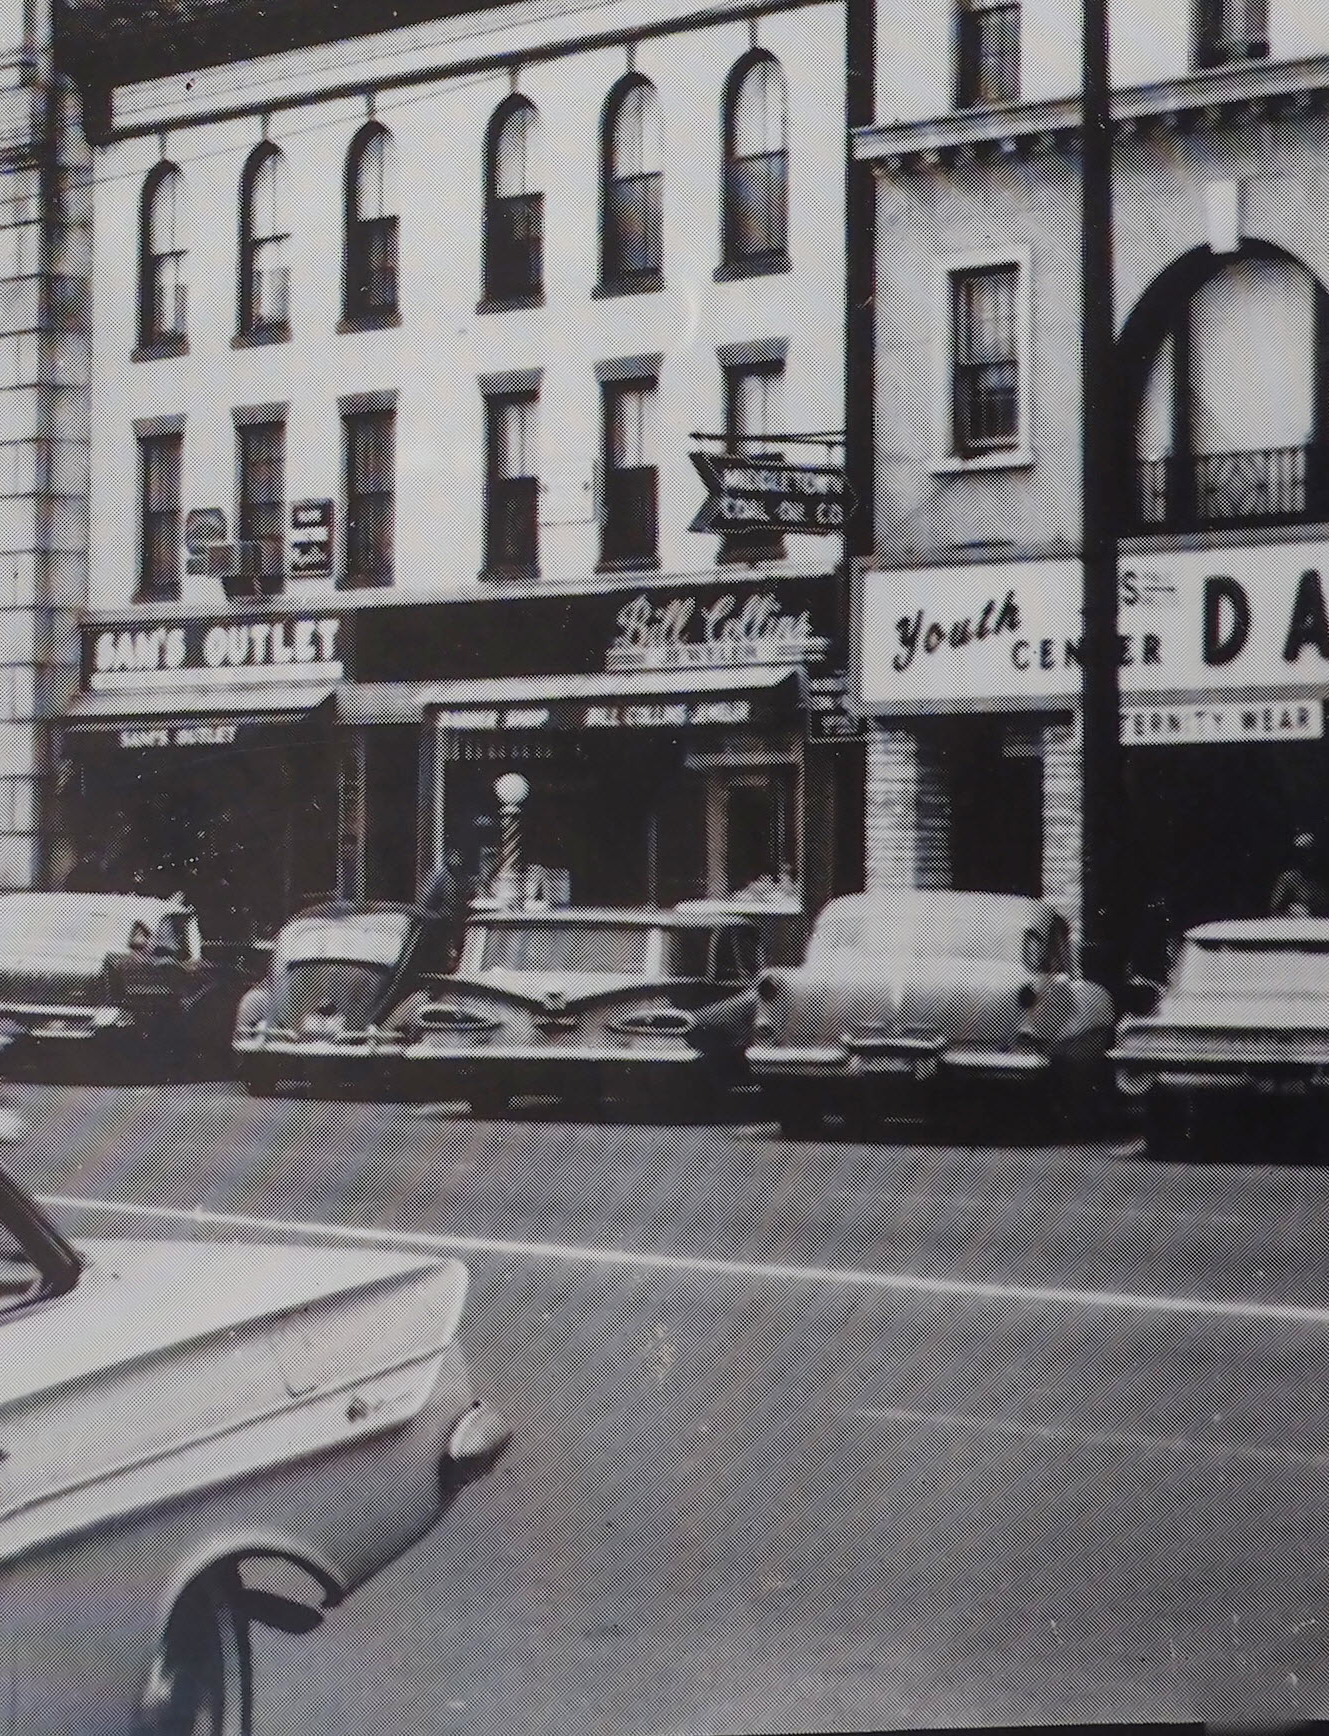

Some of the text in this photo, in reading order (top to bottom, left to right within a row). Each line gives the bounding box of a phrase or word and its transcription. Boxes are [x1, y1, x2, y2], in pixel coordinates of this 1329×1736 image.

[615, 593, 812, 647] Bill Collins
[892, 589, 1022, 672] Youth
[94, 618, 340, 671] SAM'S OUTLET
[1012, 633, 1162, 671] CENER
[175, 725, 238, 746] OUTLET
[1240, 706, 1310, 734] WEAR
